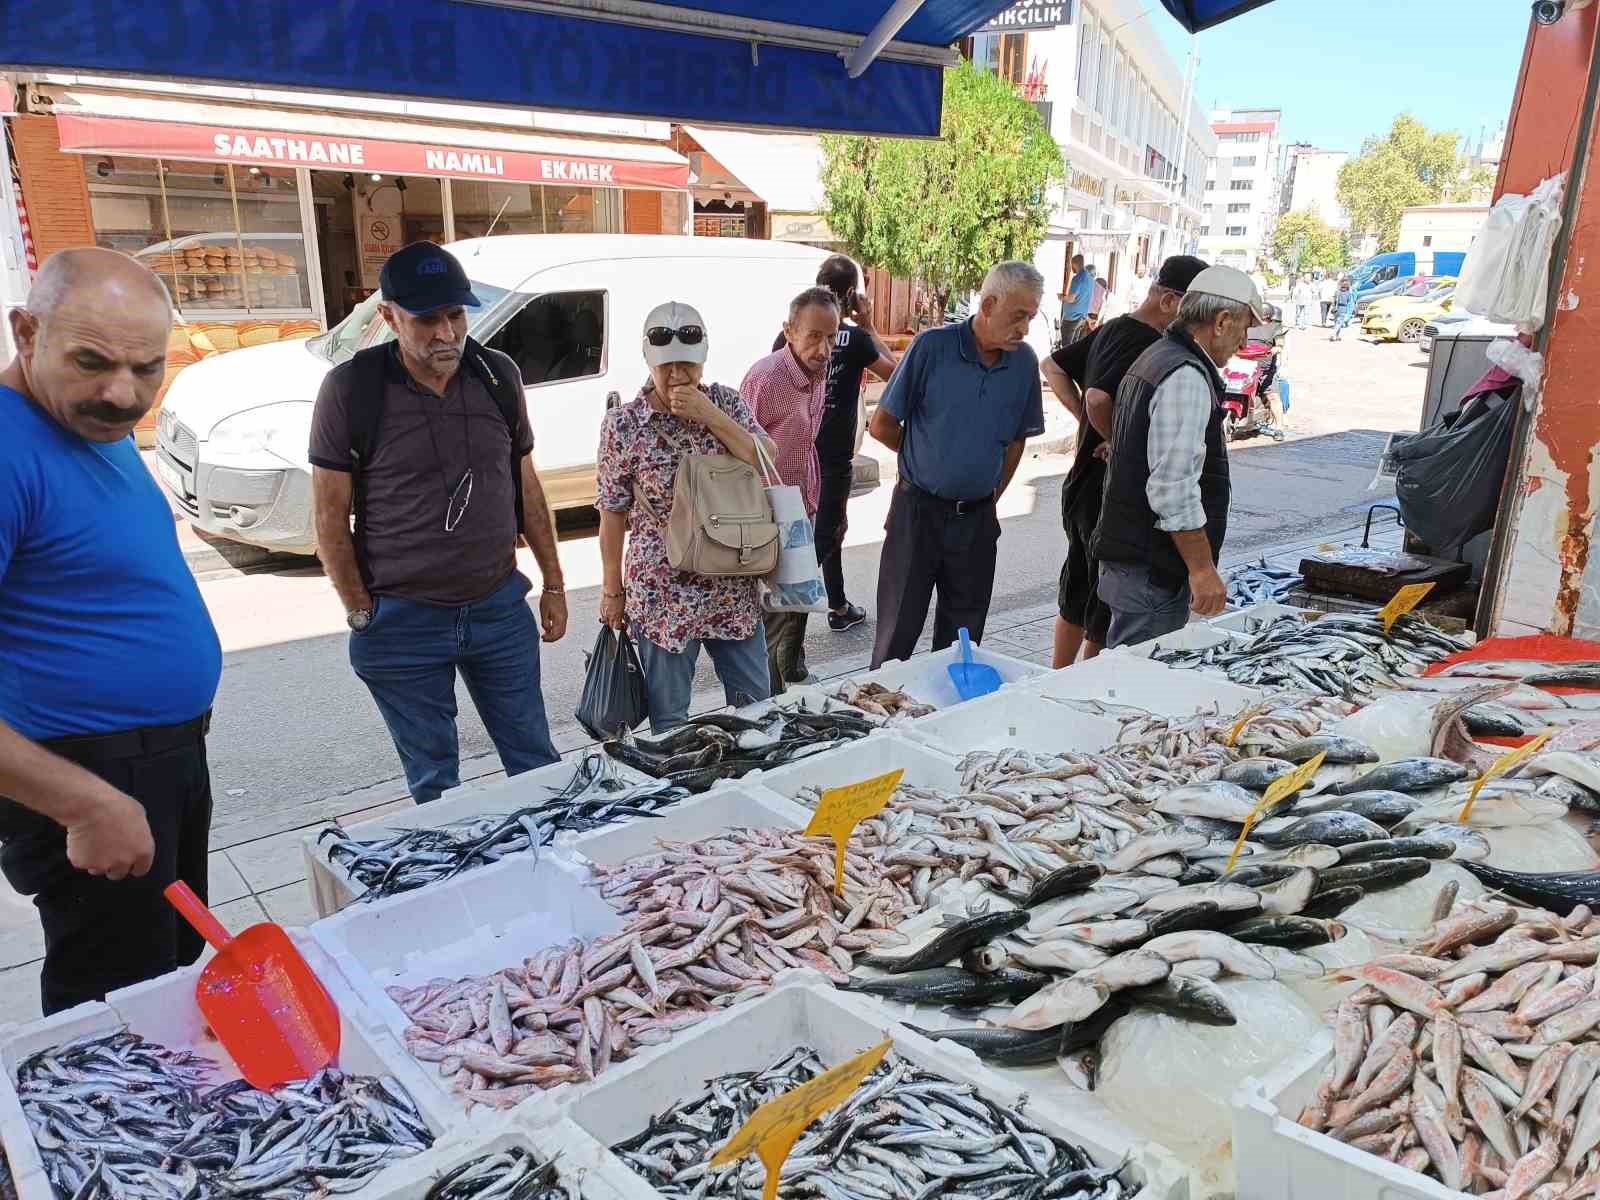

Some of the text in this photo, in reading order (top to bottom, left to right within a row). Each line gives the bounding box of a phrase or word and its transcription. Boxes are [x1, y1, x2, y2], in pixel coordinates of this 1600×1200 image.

[213, 133, 614, 183] SAATHANE NAMLI EKMEK
